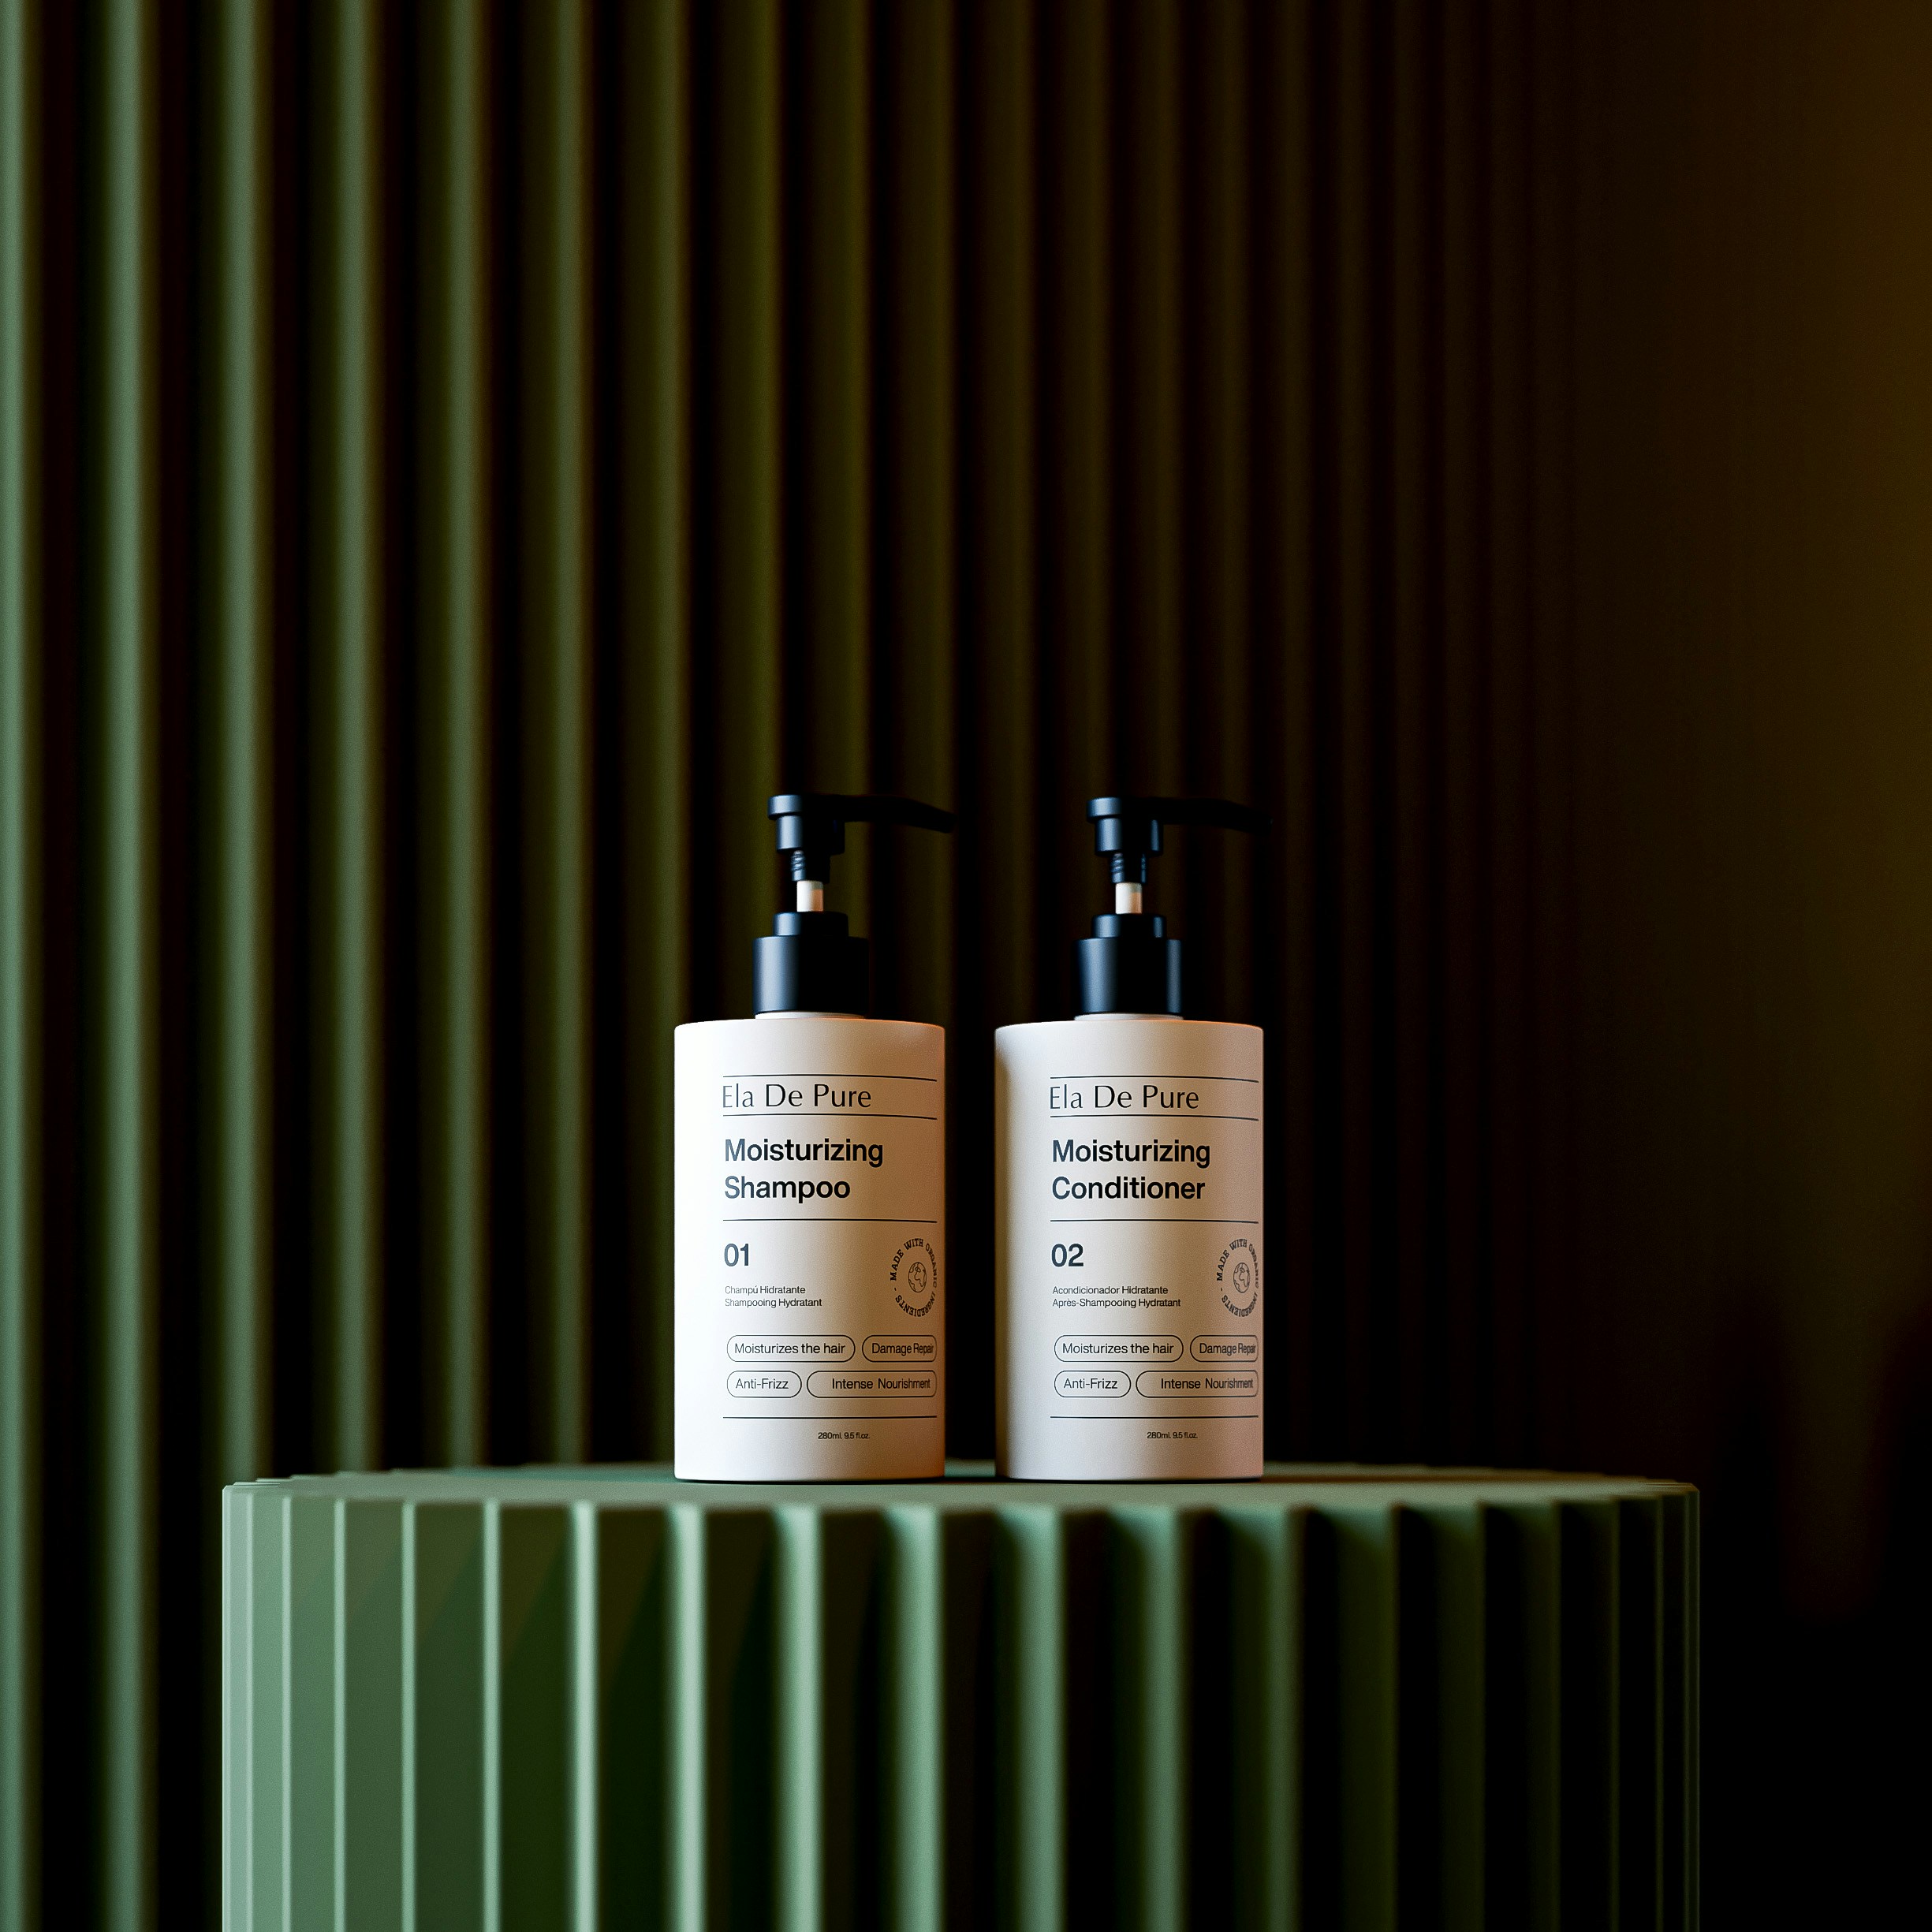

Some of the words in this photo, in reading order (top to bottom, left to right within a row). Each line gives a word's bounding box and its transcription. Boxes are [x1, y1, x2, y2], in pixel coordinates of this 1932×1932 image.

[722, 1083, 754, 1108] Ela
[765, 1083, 803, 1107] De
[814, 1083, 871, 1108] Pure
[1050, 1084, 1083, 1109] Ela
[1095, 1085, 1132, 1108] De
[1143, 1085, 1199, 1109] Pure
[725, 1138, 883, 1168] Moisturizing
[1052, 1139, 1210, 1169] Moisturizing
[724, 1175, 851, 1204] Shampoo
[1052, 1176, 1206, 1199] Conditioner
[724, 1243, 749, 1266] 01
[890, 1248, 904, 1281] MADE
[903, 1237, 924, 1251] WITH
[1051, 1244, 1084, 1267] 02
[1216, 1249, 1230, 1282] MADE
[1229, 1238, 1248, 1251] WITH
[725, 1285, 759, 1296] Champú
[759, 1285, 806, 1294] Hidratante
[1052, 1285, 1121, 1295] Acondicionador
[1121, 1285, 1169, 1295] Hidratante
[725, 1298, 777, 1308] Shampooing
[778, 1298, 822, 1308] Hydratant
[1052, 1298, 1137, 1309] Après-Shampooing
[1138, 1298, 1181, 1309] Hydratant
[734, 1343, 799, 1354] Moisturizes
[800, 1343, 821, 1354] the
[822, 1343, 846, 1354] hair
[871, 1342, 912, 1356] Damage
[913, 1343, 934, 1356] Repair
[1062, 1342, 1128, 1354] Moisturizes
[1130, 1343, 1150, 1354] the
[1152, 1343, 1174, 1354] hair
[1199, 1342, 1237, 1356] Damage
[735, 1378, 789, 1389] Anti-Frizz
[832, 1378, 874, 1389] Intense
[878, 1378, 931, 1389] Nourishment
[1063, 1378, 1118, 1389] Anti-Frizz
[1161, 1378, 1201, 1389] Intense
[1205, 1378, 1254, 1389] Nourishment
